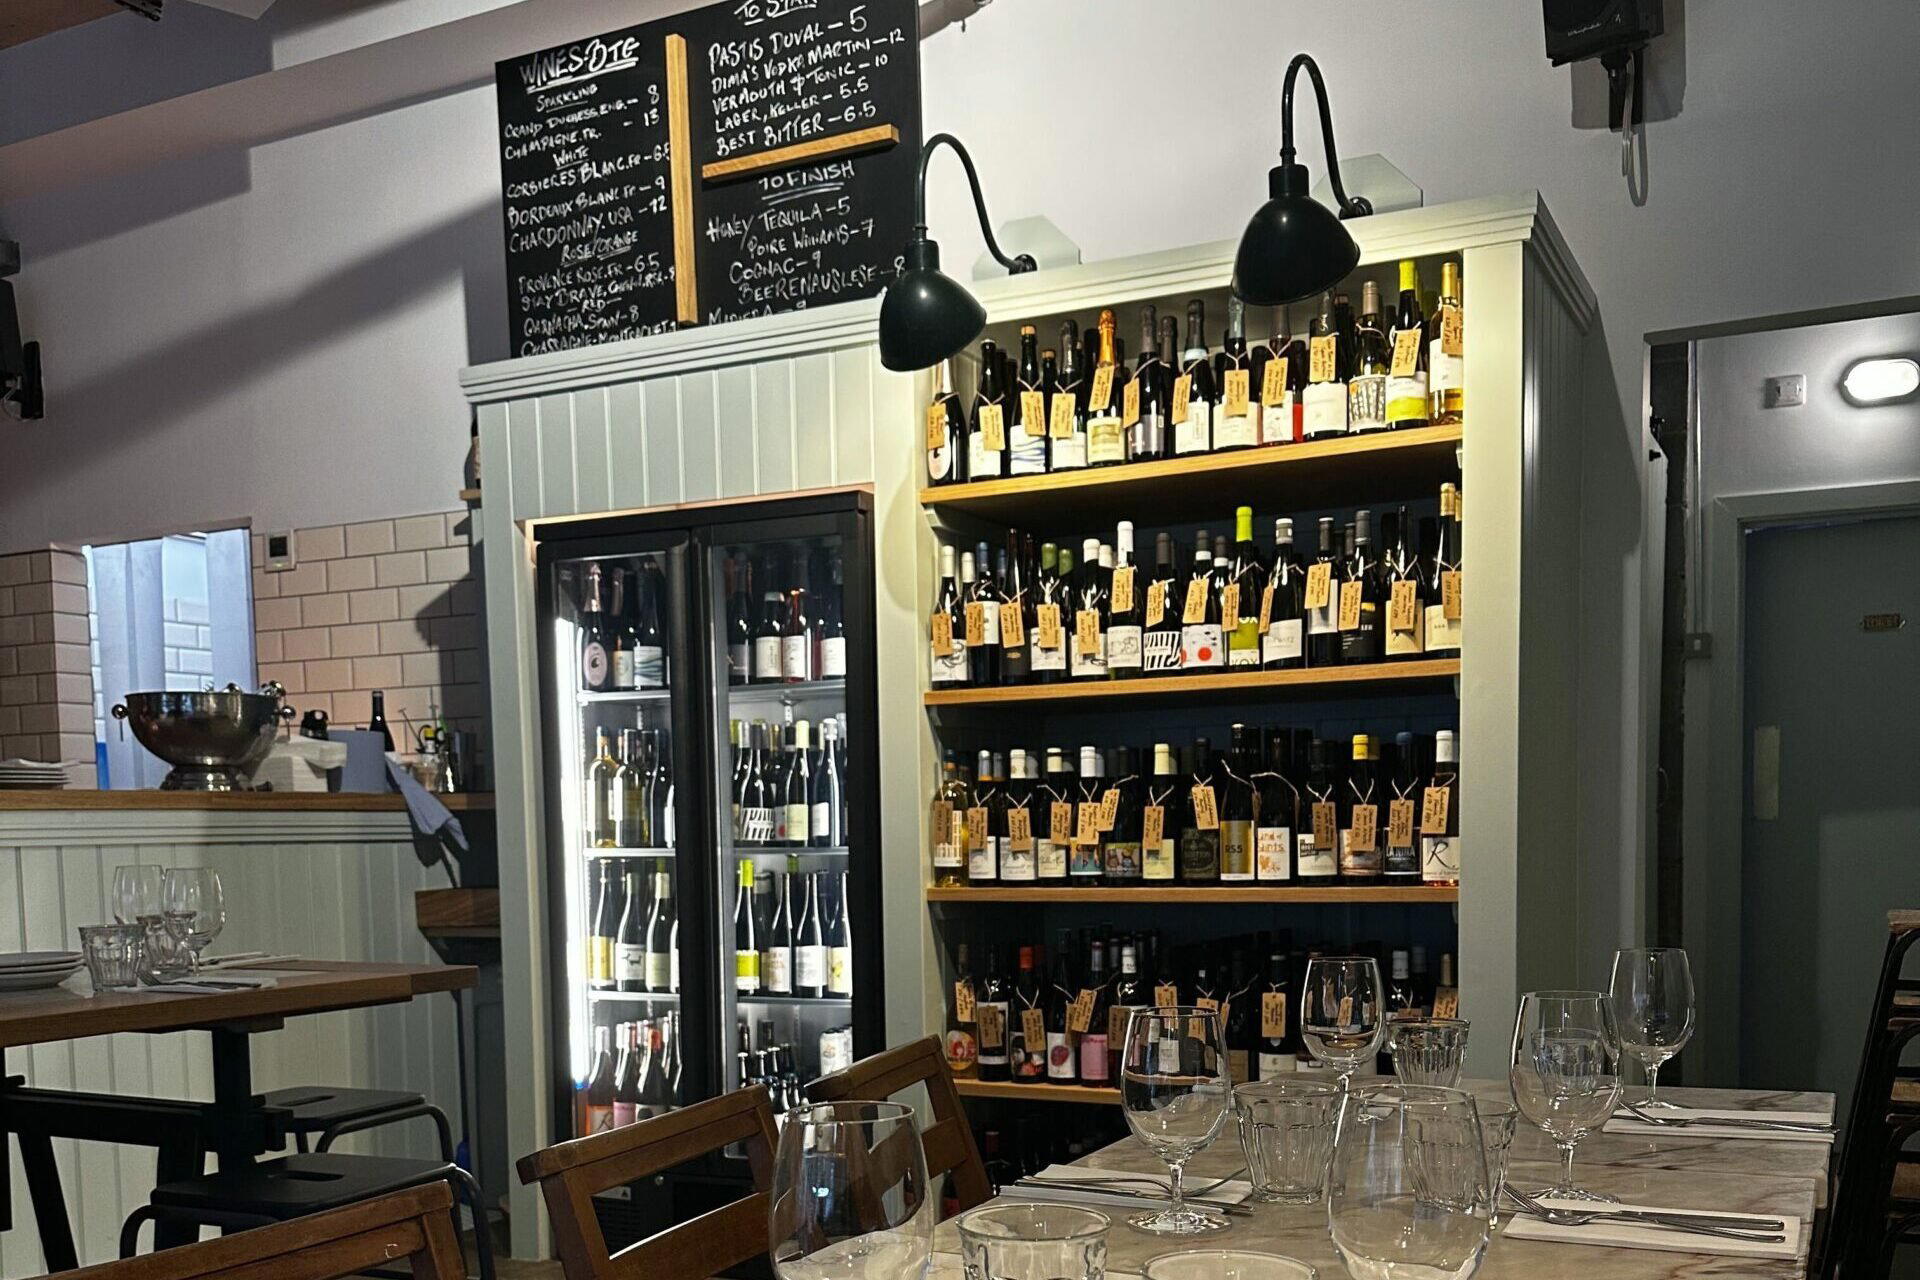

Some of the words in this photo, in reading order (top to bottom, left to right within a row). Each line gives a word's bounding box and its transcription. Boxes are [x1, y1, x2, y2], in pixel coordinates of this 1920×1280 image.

[708, 38, 764, 75] PASTIS
[769, 22, 824, 54] DUVAL
[711, 64, 759, 94] DIMA'S
[763, 54, 805, 80] VODKA
[808, 38, 870, 65] MARTINI
[536, 84, 598, 112] SPARKLING
[713, 80, 785, 115] VERMOUTH
[806, 62, 856, 85] TONIC
[769, 94, 820, 119] KELLER
[717, 131, 757, 157] BEST
[764, 112, 824, 147] BITTER
[553, 145, 589, 167] WHITE
[787, 160, 855, 188] FINISH
[507, 201, 573, 229] BORDEAUX
[757, 202, 823, 232] TEQUILA
[729, 257, 795, 284] COGNAC
